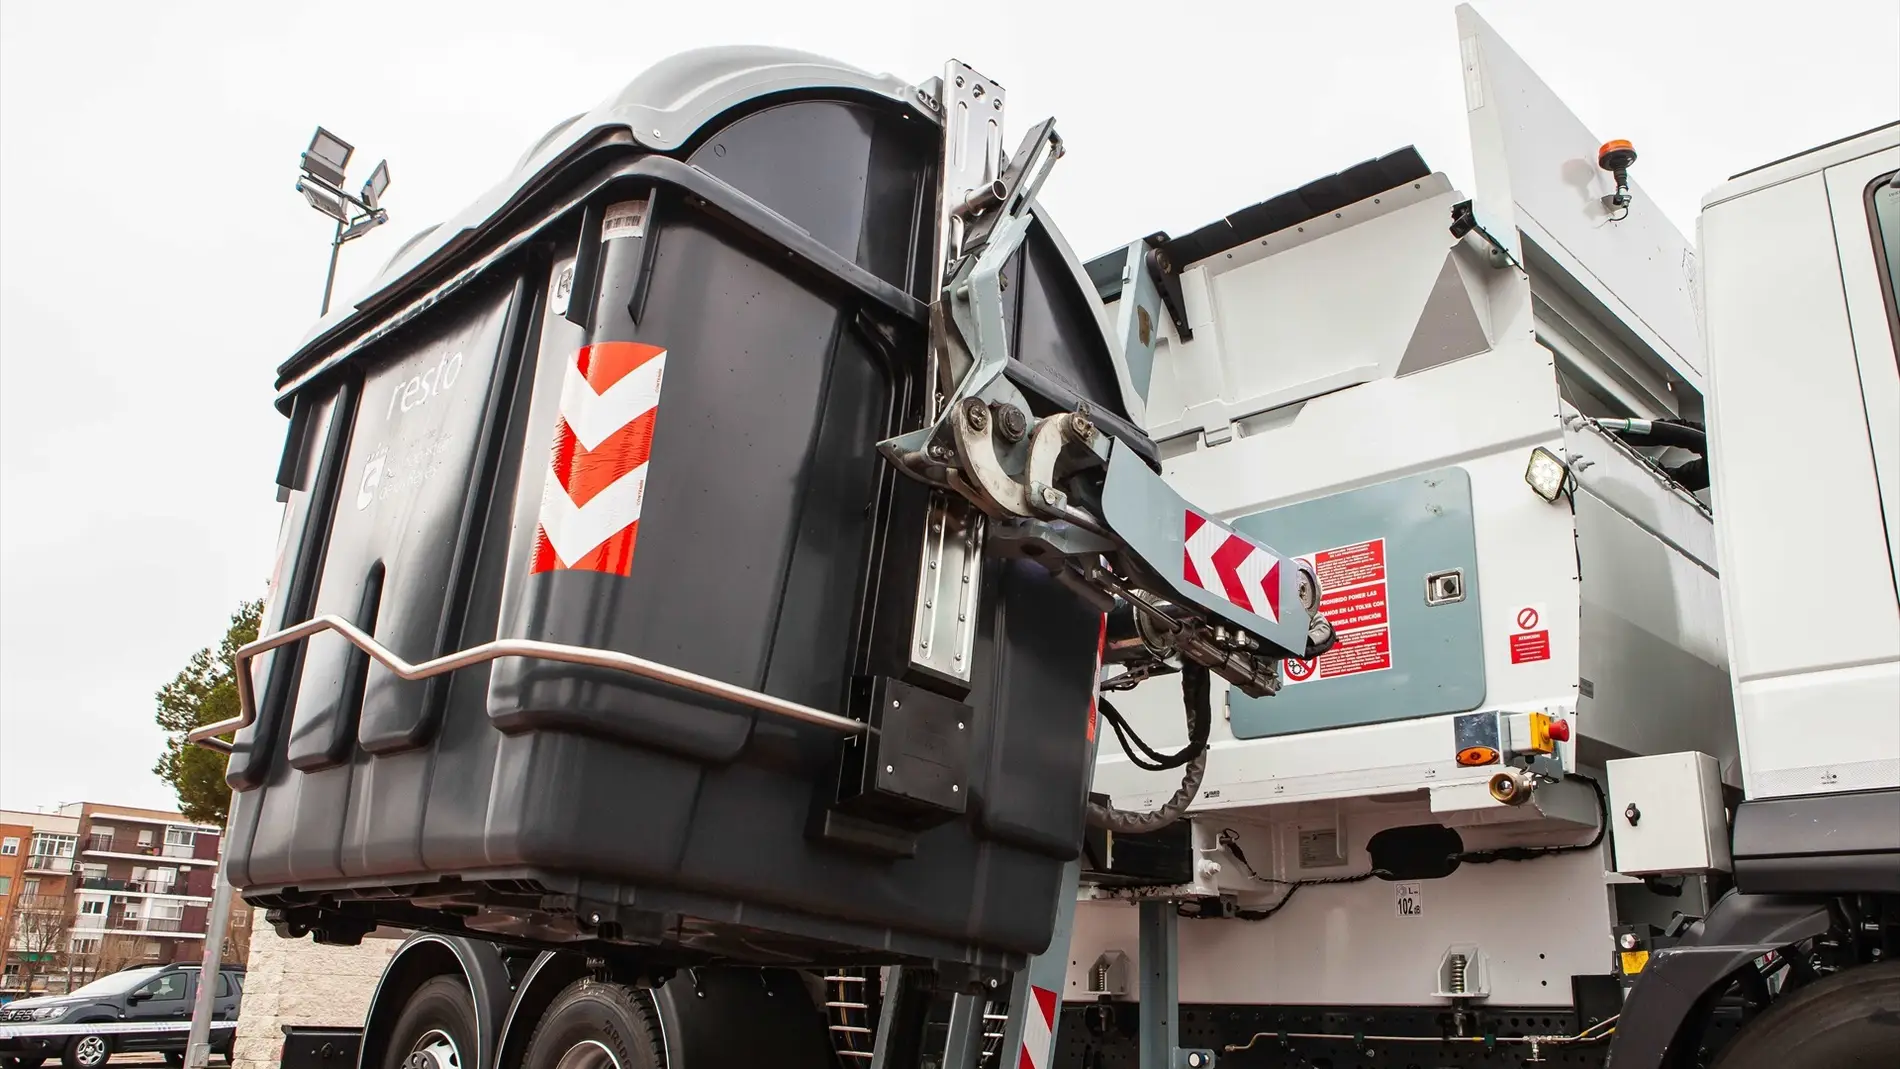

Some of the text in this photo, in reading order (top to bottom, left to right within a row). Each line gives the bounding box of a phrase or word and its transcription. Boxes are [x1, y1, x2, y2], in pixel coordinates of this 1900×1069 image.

[386, 351, 463, 420] resto
[1320, 596, 1347, 606] PROHIBIDO
[1348, 593, 1366, 601] PONER
[1355, 603, 1372, 611] TOLVA
[1372, 600, 1384, 608] CON
[1397, 897, 1413, 915] 102
